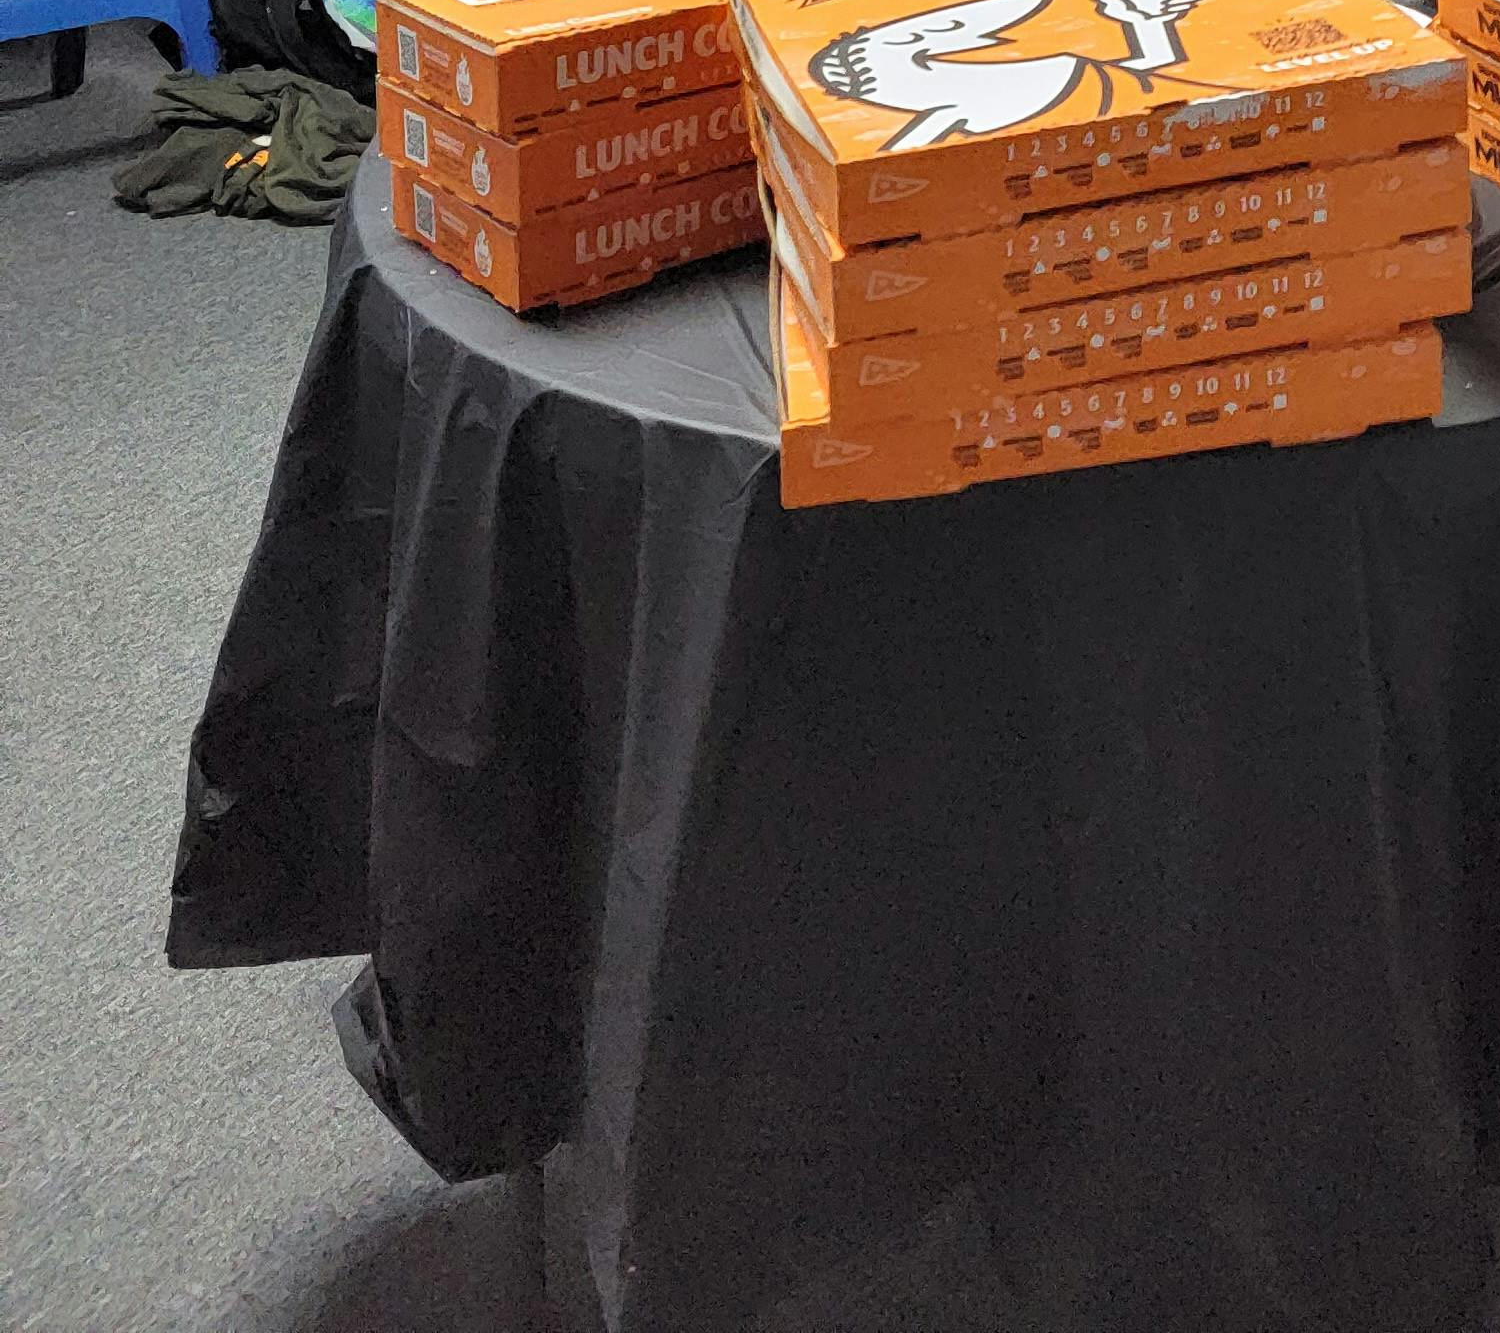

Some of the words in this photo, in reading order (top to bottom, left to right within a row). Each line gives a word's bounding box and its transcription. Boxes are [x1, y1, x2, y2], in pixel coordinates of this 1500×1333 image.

[556, 30, 685, 90] LUNCH
[1260, 51, 1350, 72] LEVEL
[1351, 38, 1393, 55] UP
[575, 115, 699, 179] LUNCH
[1007, 142, 1015, 161] 1
[1031, 136, 1041, 157] 2
[1083, 128, 1095, 147] 4
[1110, 125, 1120, 142] 5
[1136, 121, 1148, 137] 6
[1275, 95, 1290, 114] 11
[1305, 90, 1324, 107] 12
[575, 200, 701, 265] LUNCH
[1006, 238, 1013, 257] 1
[1029, 235, 1040, 253] 2
[1055, 229, 1066, 247] 3
[1082, 225, 1095, 242] 4
[1109, 219, 1120, 237] 5
[1136, 215, 1148, 232] 6
[1162, 211, 1173, 229] 7
[1187, 205, 1199, 223] 8
[1214, 200, 1226, 218] 9
[1240, 194, 1261, 213] 10
[1276, 188, 1292, 205] 11
[1306, 183, 1325, 200] 12
[1000, 326, 1008, 343] 1
[1023, 323, 1034, 340] 2
[1049, 318, 1061, 334] 3
[1076, 309, 1088, 329] 4
[1104, 307, 1116, 325] 5
[1131, 302, 1142, 320] 6
[1157, 298, 1168, 317] 7
[1183, 293, 1195, 310] 8
[1210, 288, 1222, 304] 9
[1236, 281, 1257, 300] 10
[1271, 277, 1289, 294] 11
[1303, 269, 1323, 288] 12
[953, 411, 962, 430] 1
[979, 409, 991, 427] 2
[1006, 406, 1017, 423] 3
[1033, 401, 1045, 419] 4
[1060, 398, 1072, 416] 5
[1088, 394, 1100, 412] 6
[1114, 391, 1126, 408] 7
[1142, 387, 1154, 404] 8
[1169, 382, 1181, 400] 9
[1196, 376, 1219, 395] 10
[1234, 371, 1250, 391] 11
[1266, 366, 1286, 386] 12
